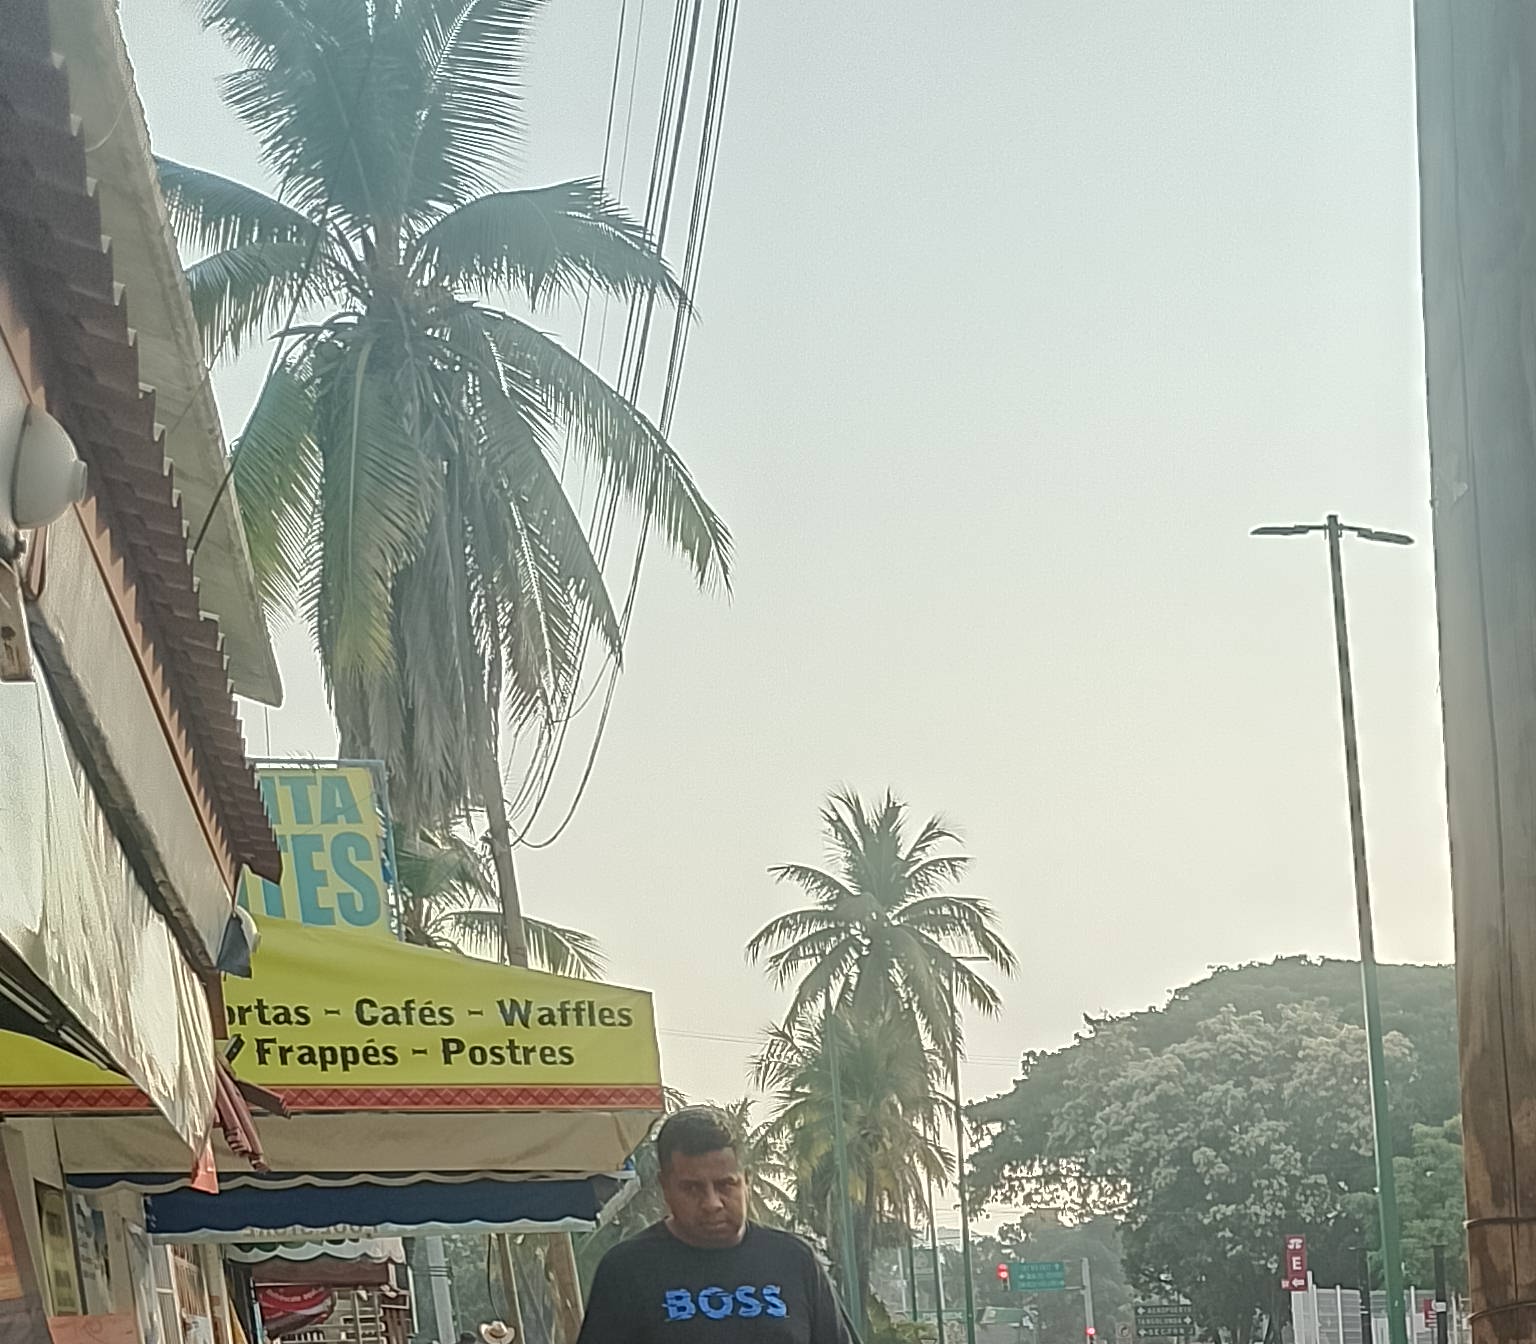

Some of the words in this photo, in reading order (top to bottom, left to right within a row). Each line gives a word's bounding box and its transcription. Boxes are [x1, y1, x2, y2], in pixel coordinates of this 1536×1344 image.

[355, 998, 455, 1027] Cafés
[498, 999, 633, 1029] Waffles
[255, 1037, 398, 1071] Frappés
[441, 1036, 575, 1066] Postres
[1292, 1256, 1302, 1271] E
[663, 1285, 788, 1321] BOSS
